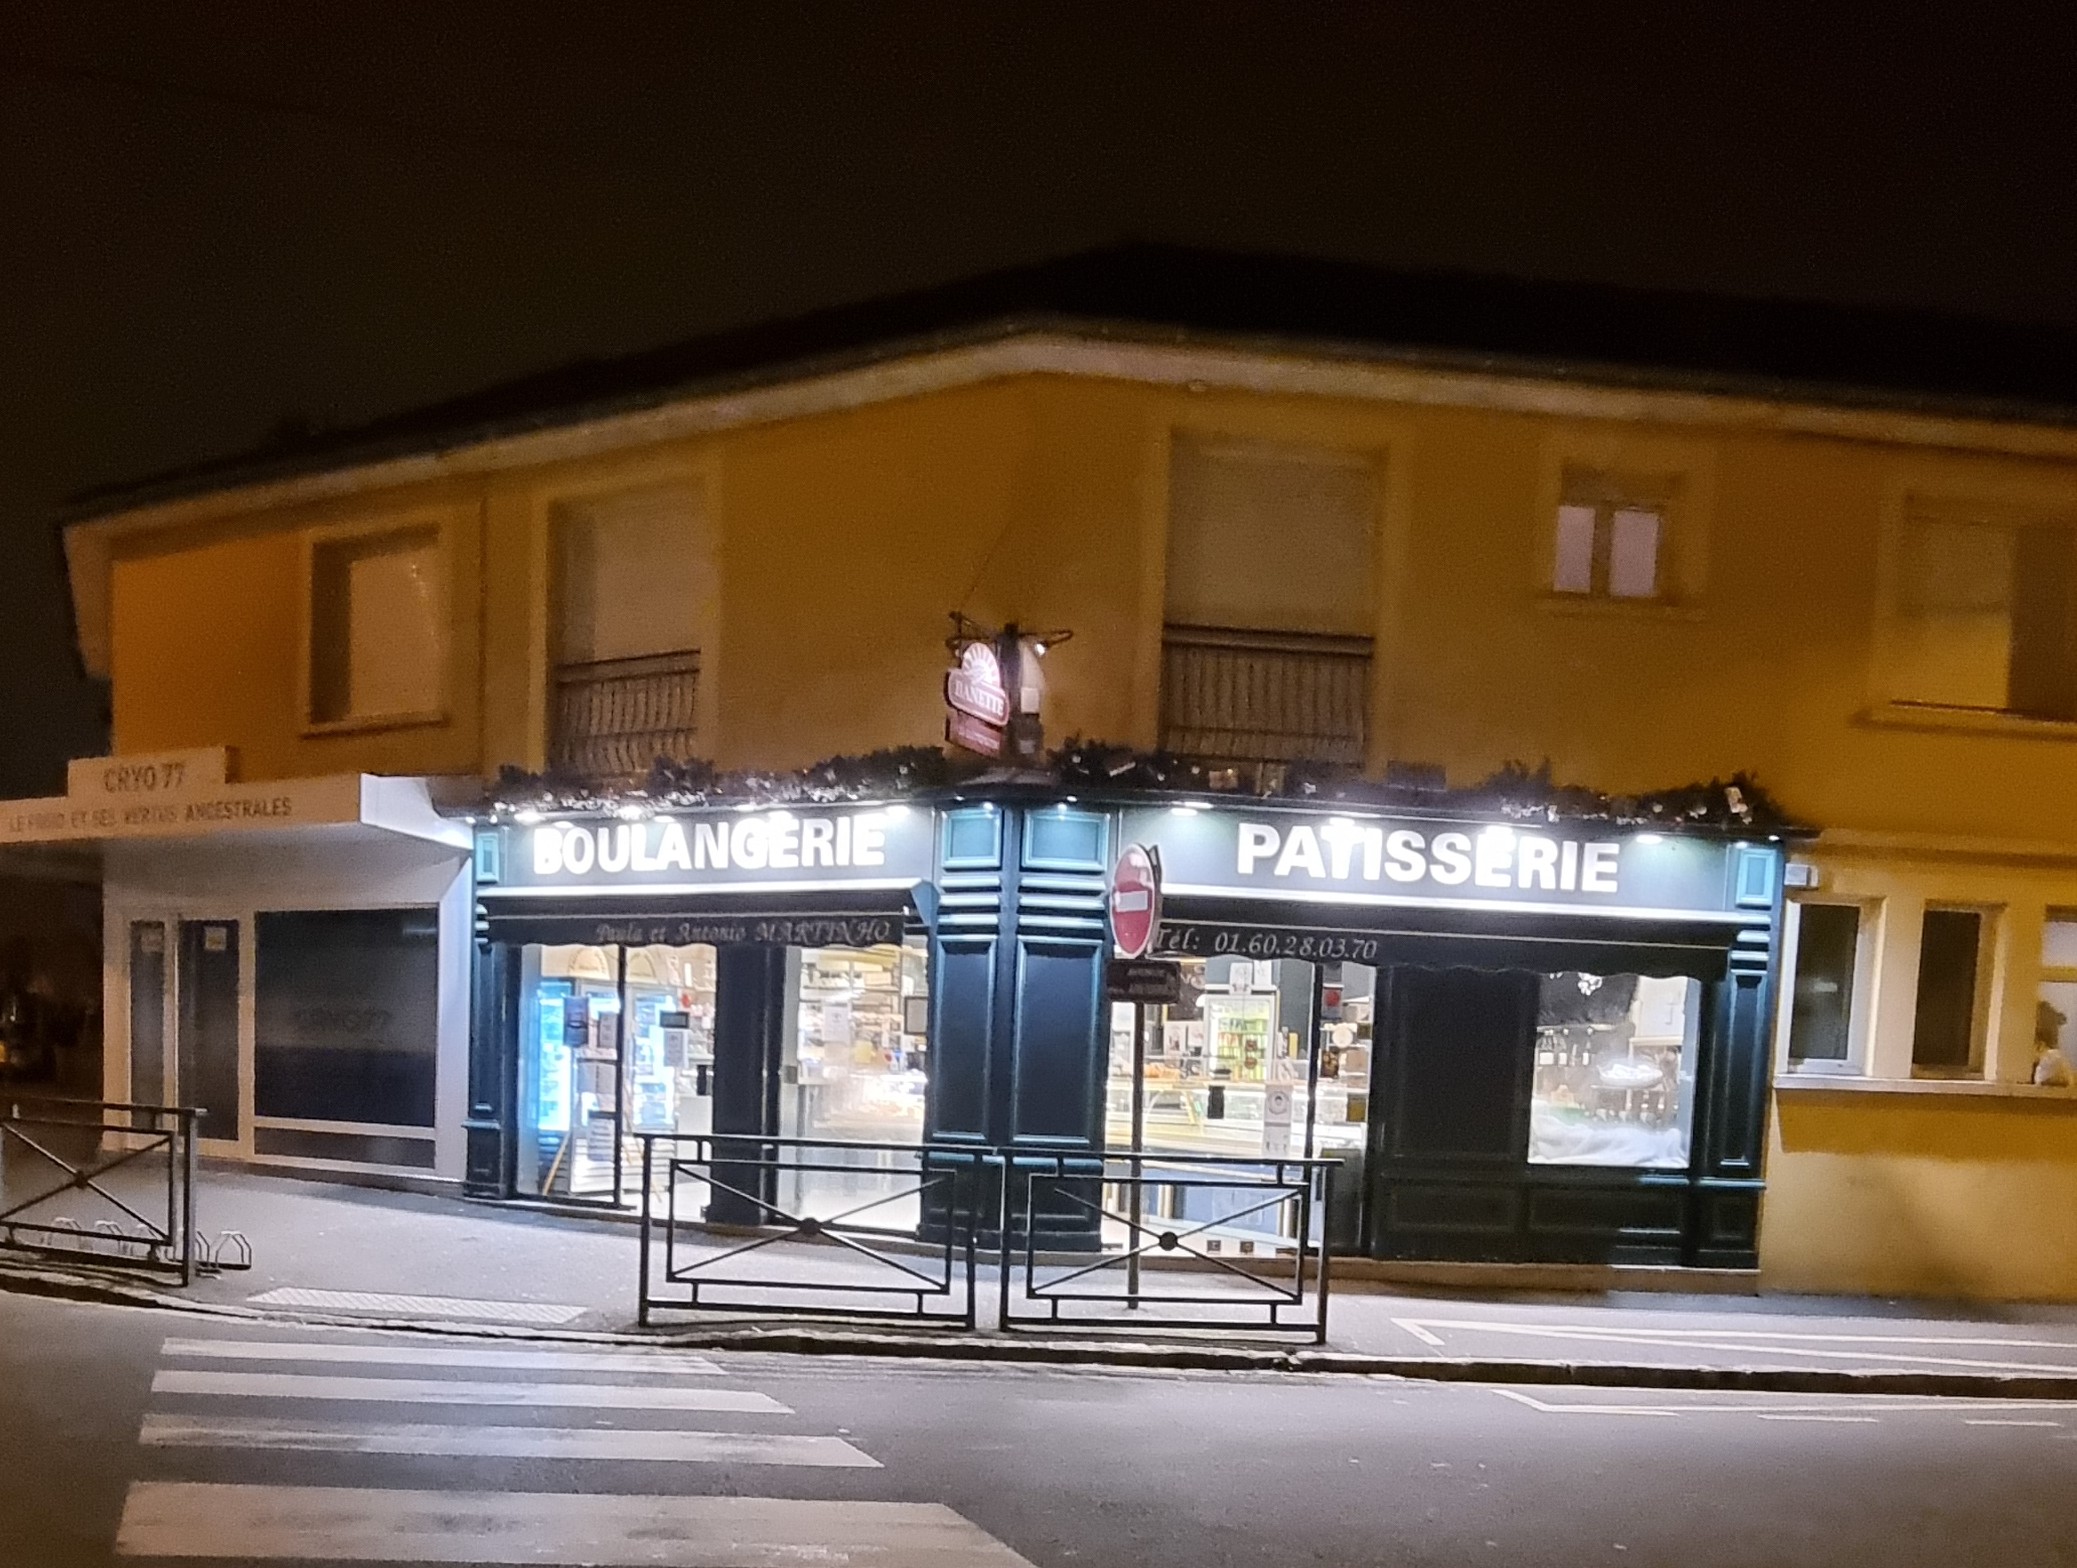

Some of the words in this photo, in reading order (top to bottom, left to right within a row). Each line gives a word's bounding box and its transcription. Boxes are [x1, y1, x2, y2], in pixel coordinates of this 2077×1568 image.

[103, 766, 156, 793] CRYO
[162, 762, 185, 789] 77
[185, 797, 292, 821] ANCESTRALES
[533, 813, 885, 875] BOULANGERIE
[1237, 821, 1620, 893] PATISSERIE
[754, 919, 890, 947] MARTINHO
[1214, 931, 1378, 960] 01.60.28.03.70
